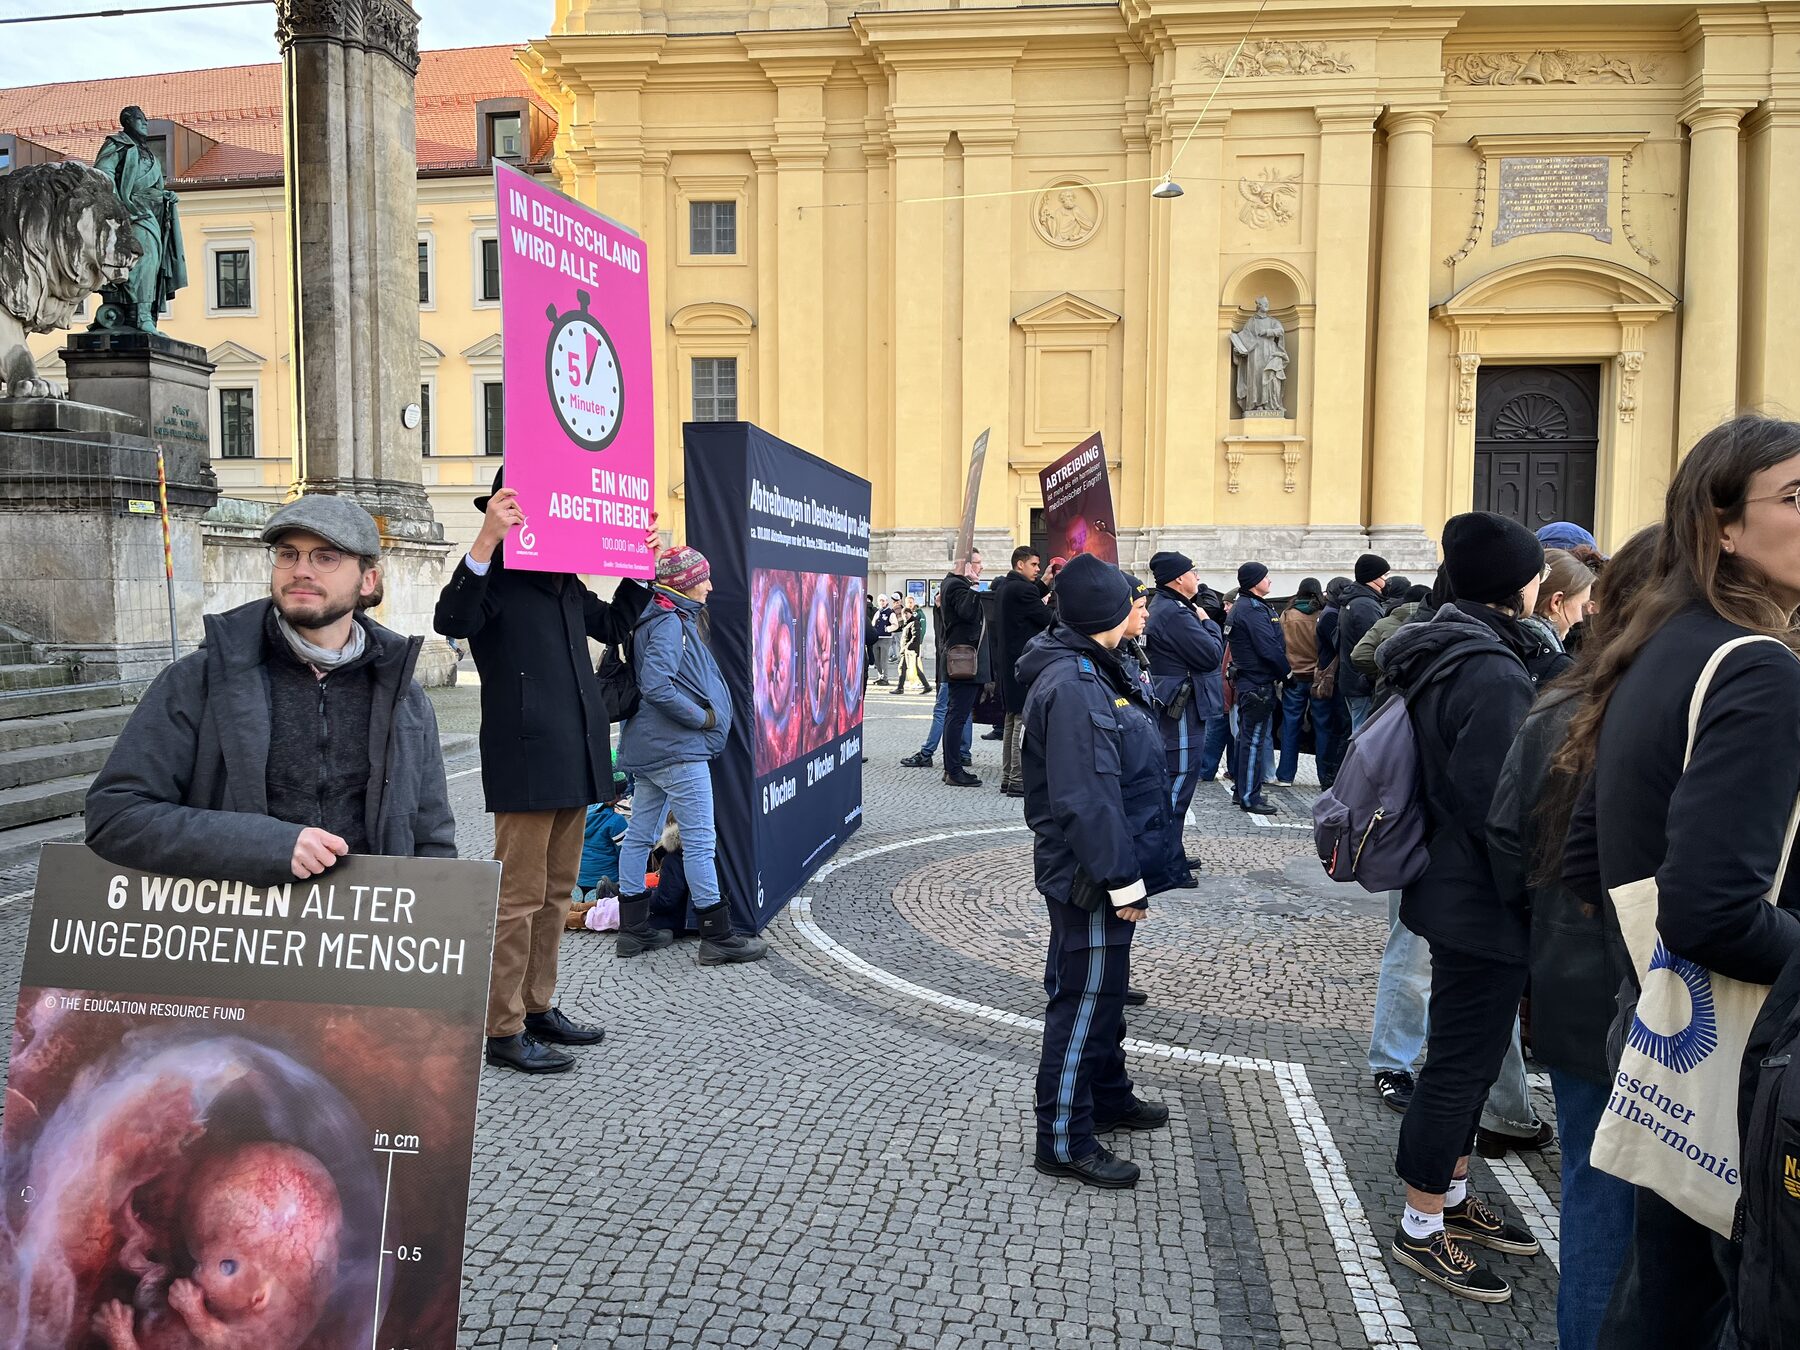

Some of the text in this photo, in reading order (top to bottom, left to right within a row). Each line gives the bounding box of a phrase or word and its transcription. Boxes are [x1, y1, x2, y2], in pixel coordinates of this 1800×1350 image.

[509, 188, 641, 274] IN DEUTSCHLAND
[510, 225, 599, 288] WIRD ALLE
[568, 351, 581, 387] 5
[569, 393, 606, 417] Minuten
[591, 467, 649, 502] EIN KIND
[1046, 445, 1099, 491] ABTREIBUNG
[548, 492, 649, 530] ABGETRIEBEN
[750, 478, 804, 528] Abtreibungen
[804, 495, 811, 525] in
[811, 498, 848, 534] Deutschland
[847, 516, 858, 540] pro
[1048, 471, 1102, 512] medizinischer Eingriff
[601, 537, 627, 552] 100.000
[806, 752, 835, 788] 12 Wochen
[762, 776, 797, 815] 6 Wochen
[107, 874, 416, 924] 6 WOCHEN ALTER
[50, 918, 466, 976] UNGEBORENER MENSCH
[59, 996, 81, 1011] THE
[83, 998, 147, 1016] EDUCATION
[149, 1002, 211, 1020] RESOURCE
[212, 1006, 246, 1022] FUND
[1616, 1071, 1696, 1126] esdner
[374, 1129, 420, 1149] in cm
[1607, 1091, 1738, 1186] ilharmonie
[397, 1245, 422, 1262] 0.5
